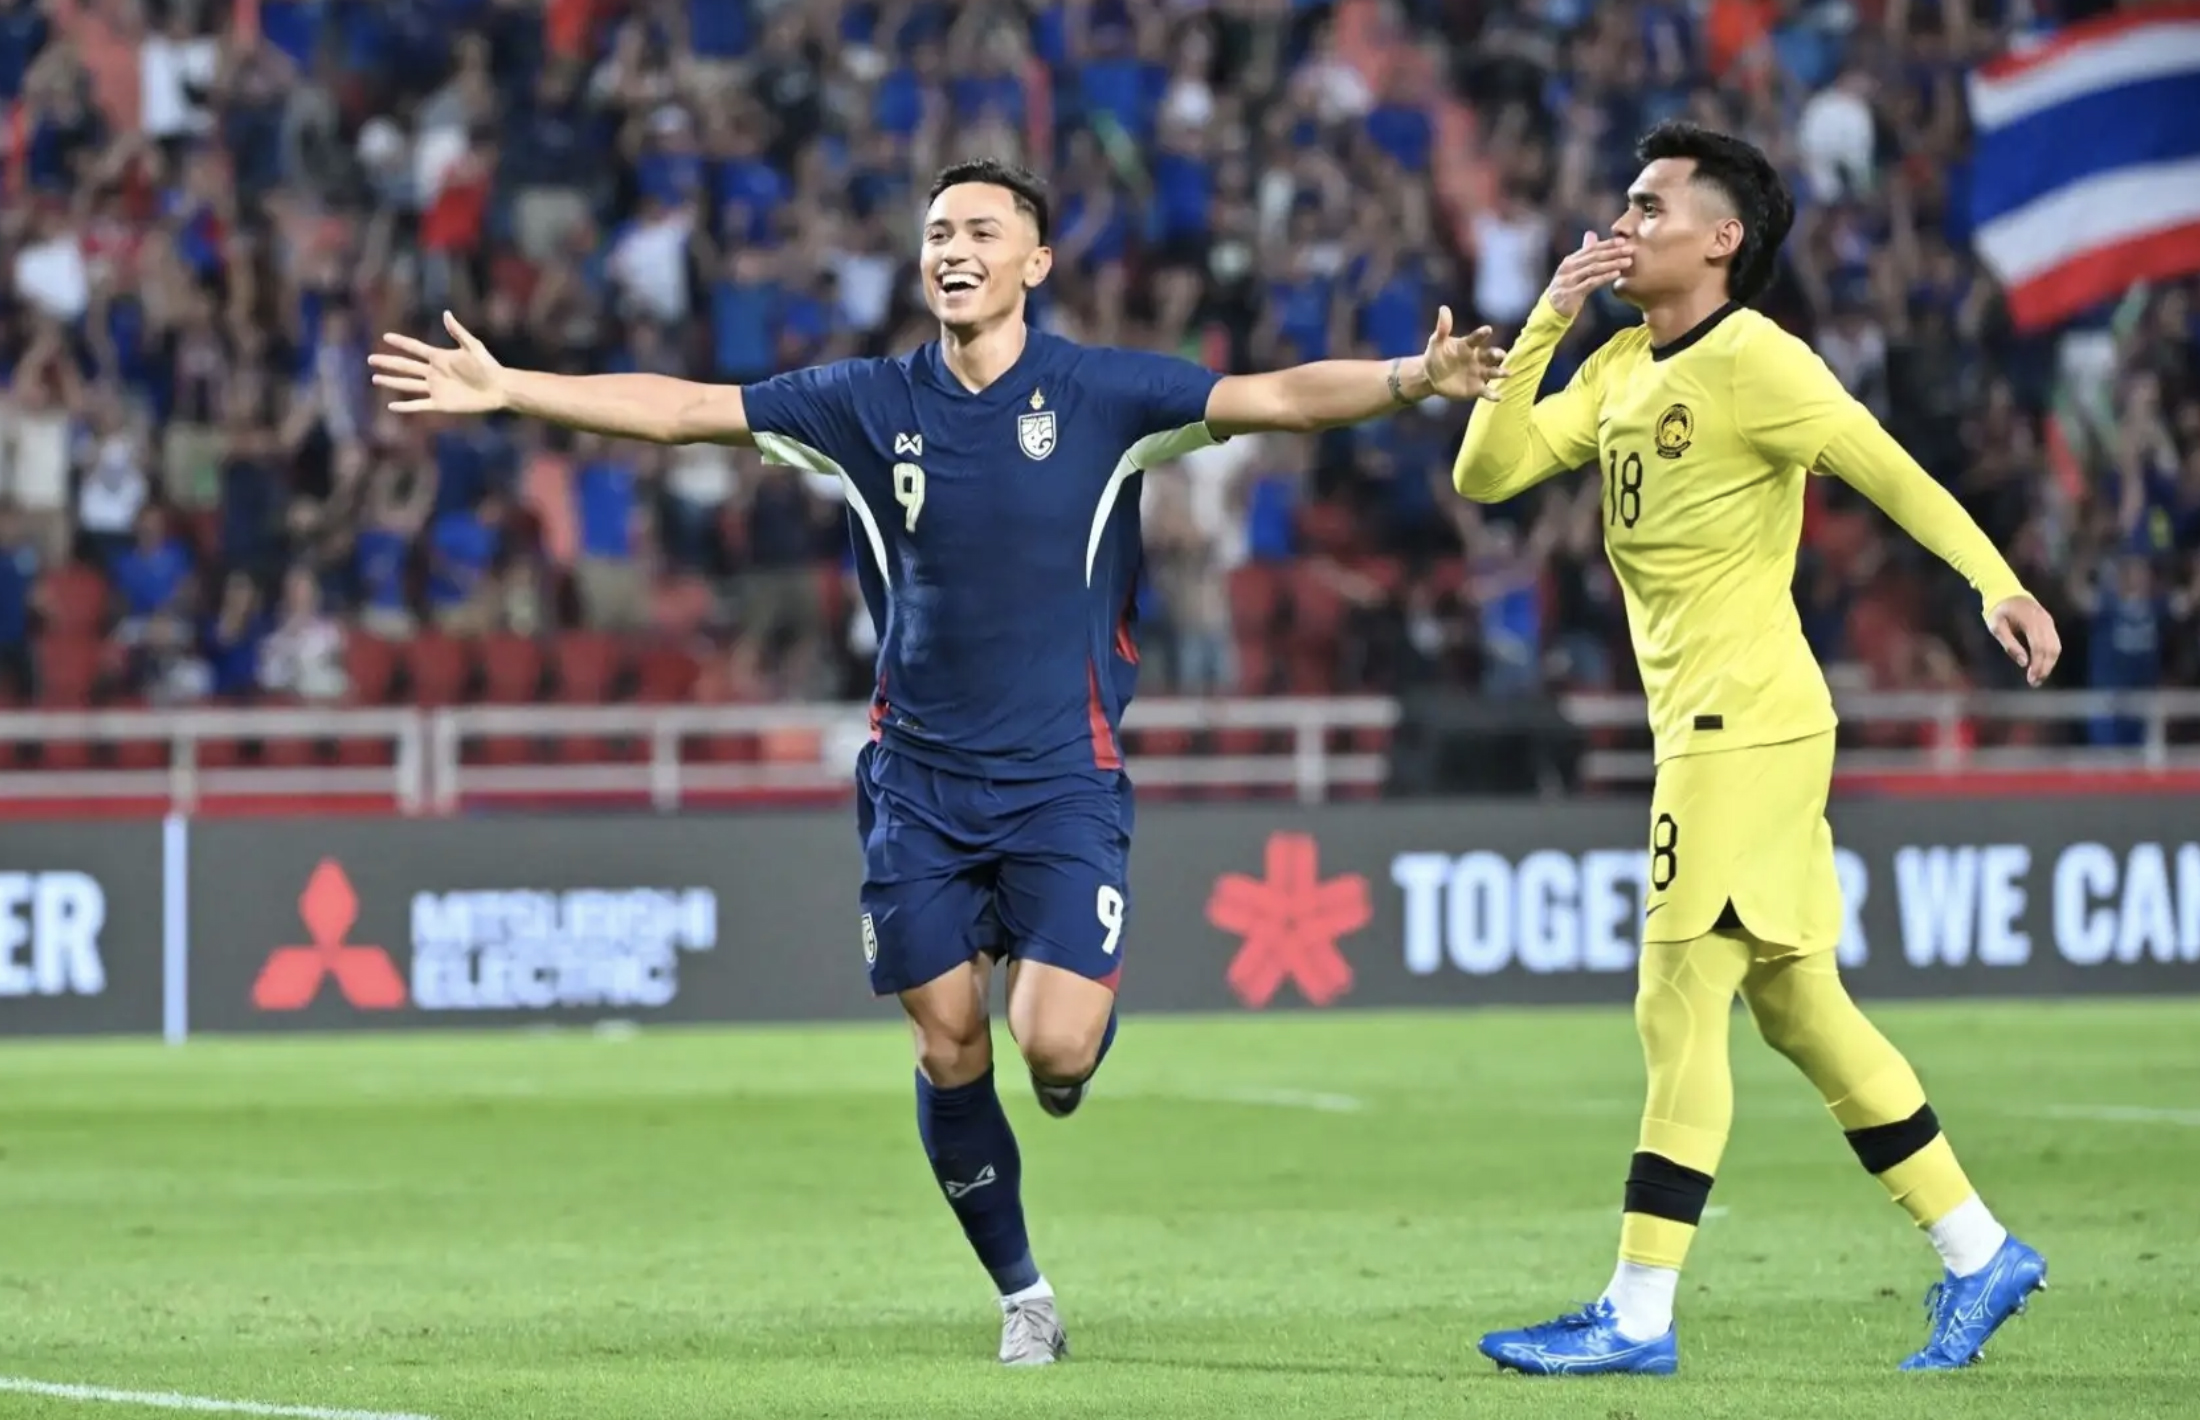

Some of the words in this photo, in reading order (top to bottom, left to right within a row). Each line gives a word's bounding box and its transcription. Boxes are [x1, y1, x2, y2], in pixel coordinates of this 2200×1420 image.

[893, 462, 925, 533] 9
[1609, 449, 1643, 529] 18
[1097, 885, 1124, 955] 9
[1390, 848, 1869, 975] TOGER
[1894, 844, 2032, 968] WE
